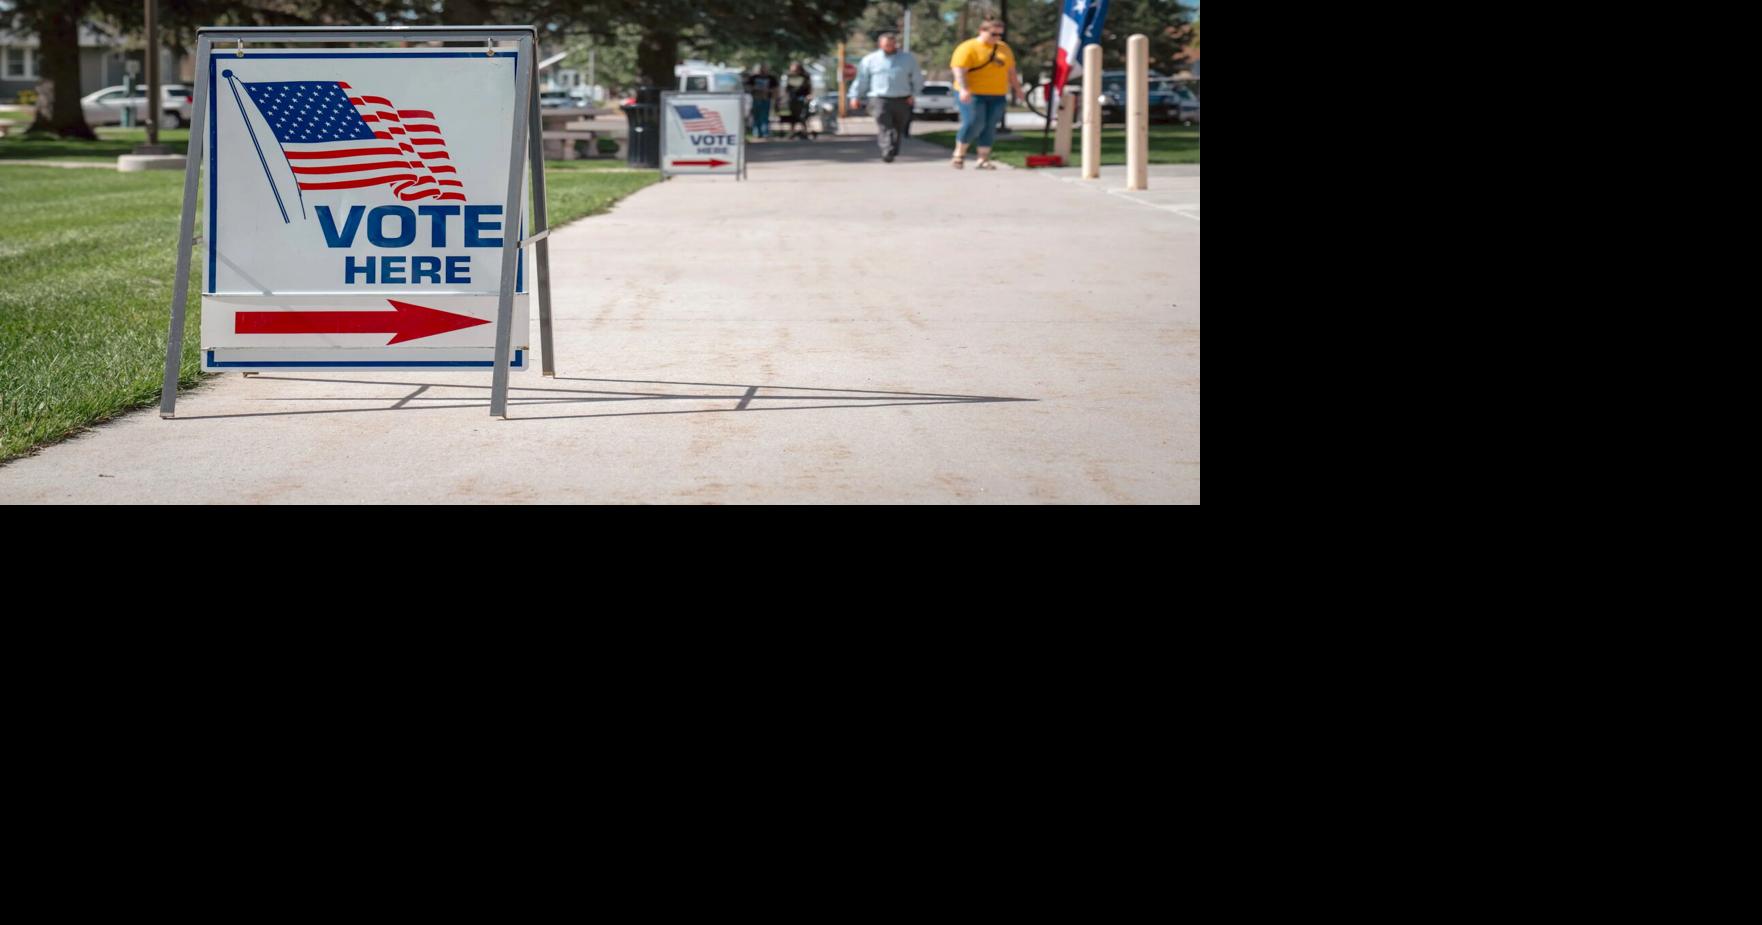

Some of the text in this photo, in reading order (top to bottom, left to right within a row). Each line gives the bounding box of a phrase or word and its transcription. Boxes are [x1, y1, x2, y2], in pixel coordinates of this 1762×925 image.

[690, 134, 736, 146] VOTE
[697, 147, 728, 155] HERE
[314, 205, 504, 248] VOTE
[345, 256, 471, 284] HERE
